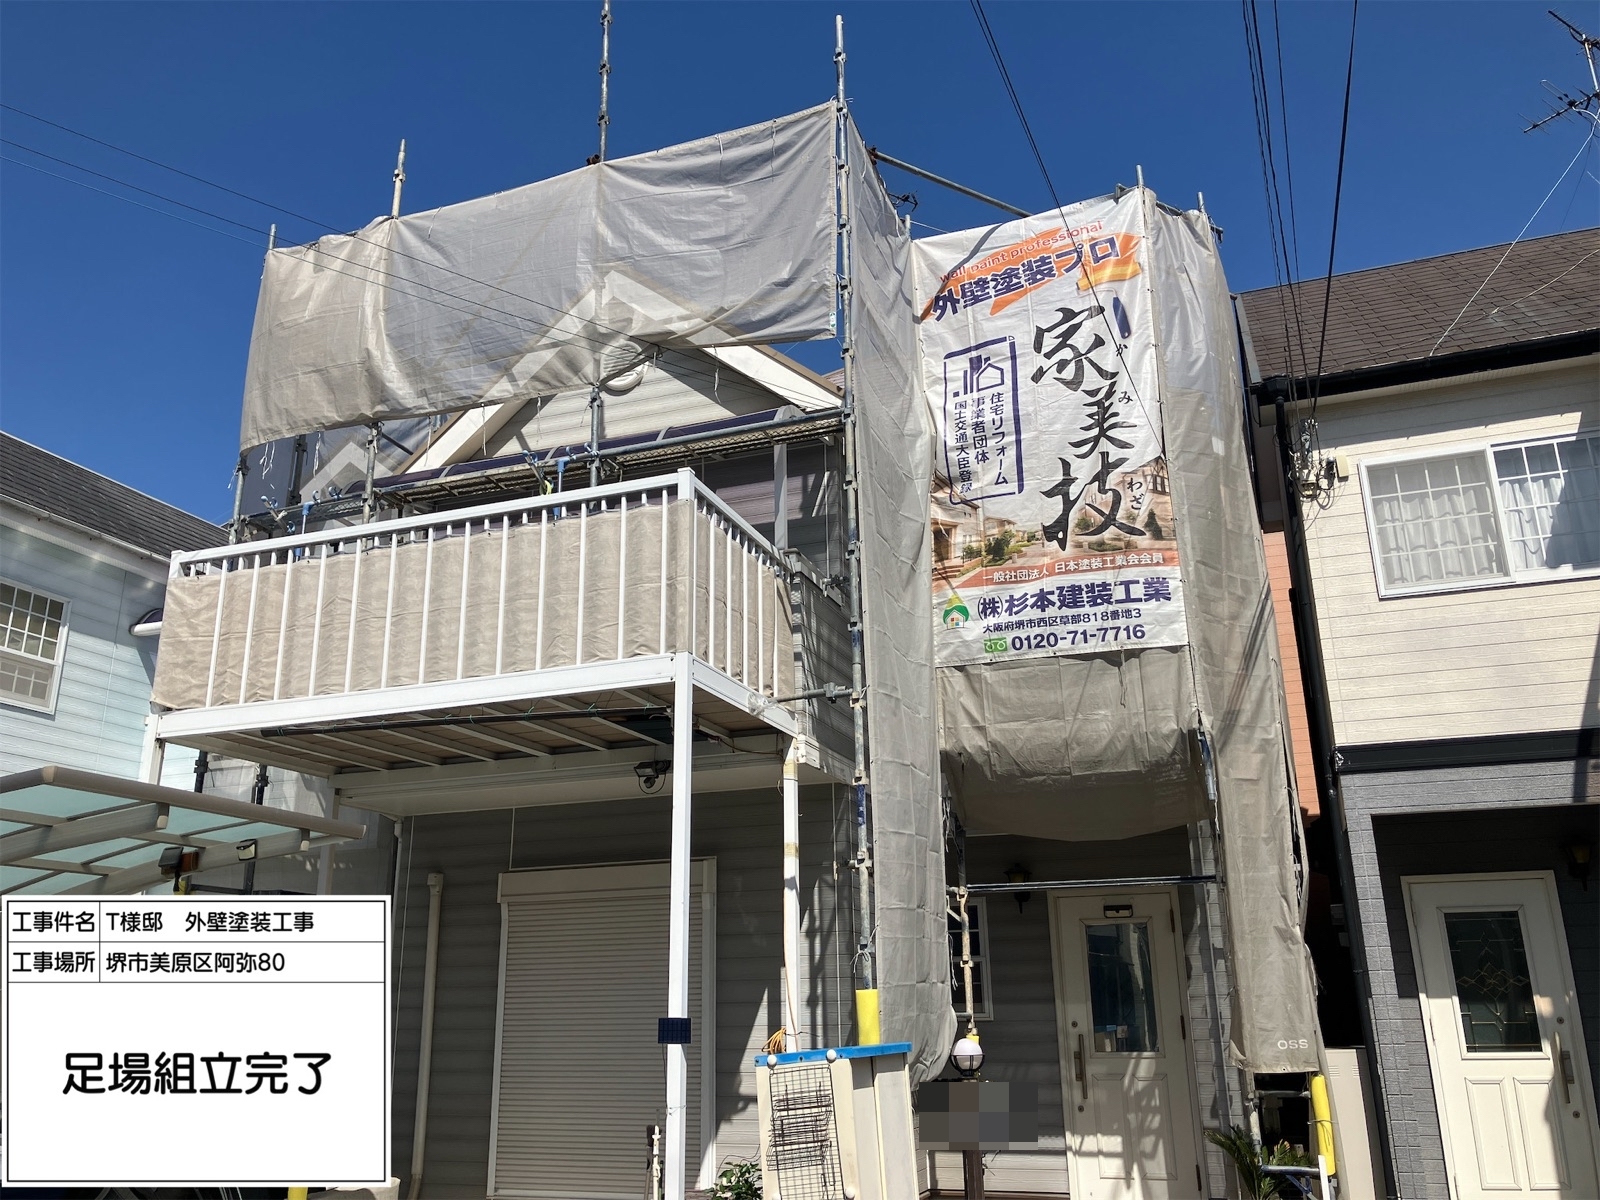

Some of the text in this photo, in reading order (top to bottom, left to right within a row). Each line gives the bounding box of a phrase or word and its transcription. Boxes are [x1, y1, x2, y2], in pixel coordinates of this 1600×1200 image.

[932, 236, 1120, 321] 外壁塗装プロ
[940, 221, 1103, 284] wall paint professional
[954, 400, 973, 495] 国土交通大臣登録
[970, 396, 990, 465] 事業者団体
[989, 392, 1009, 486] 住宅リフォーム
[982, 608, 1142, 634] 大阪府堺市西区草部818番地3
[1011, 624, 1146, 651] 0120-71-7716
[1277, 1039, 1309, 1050] OSS
